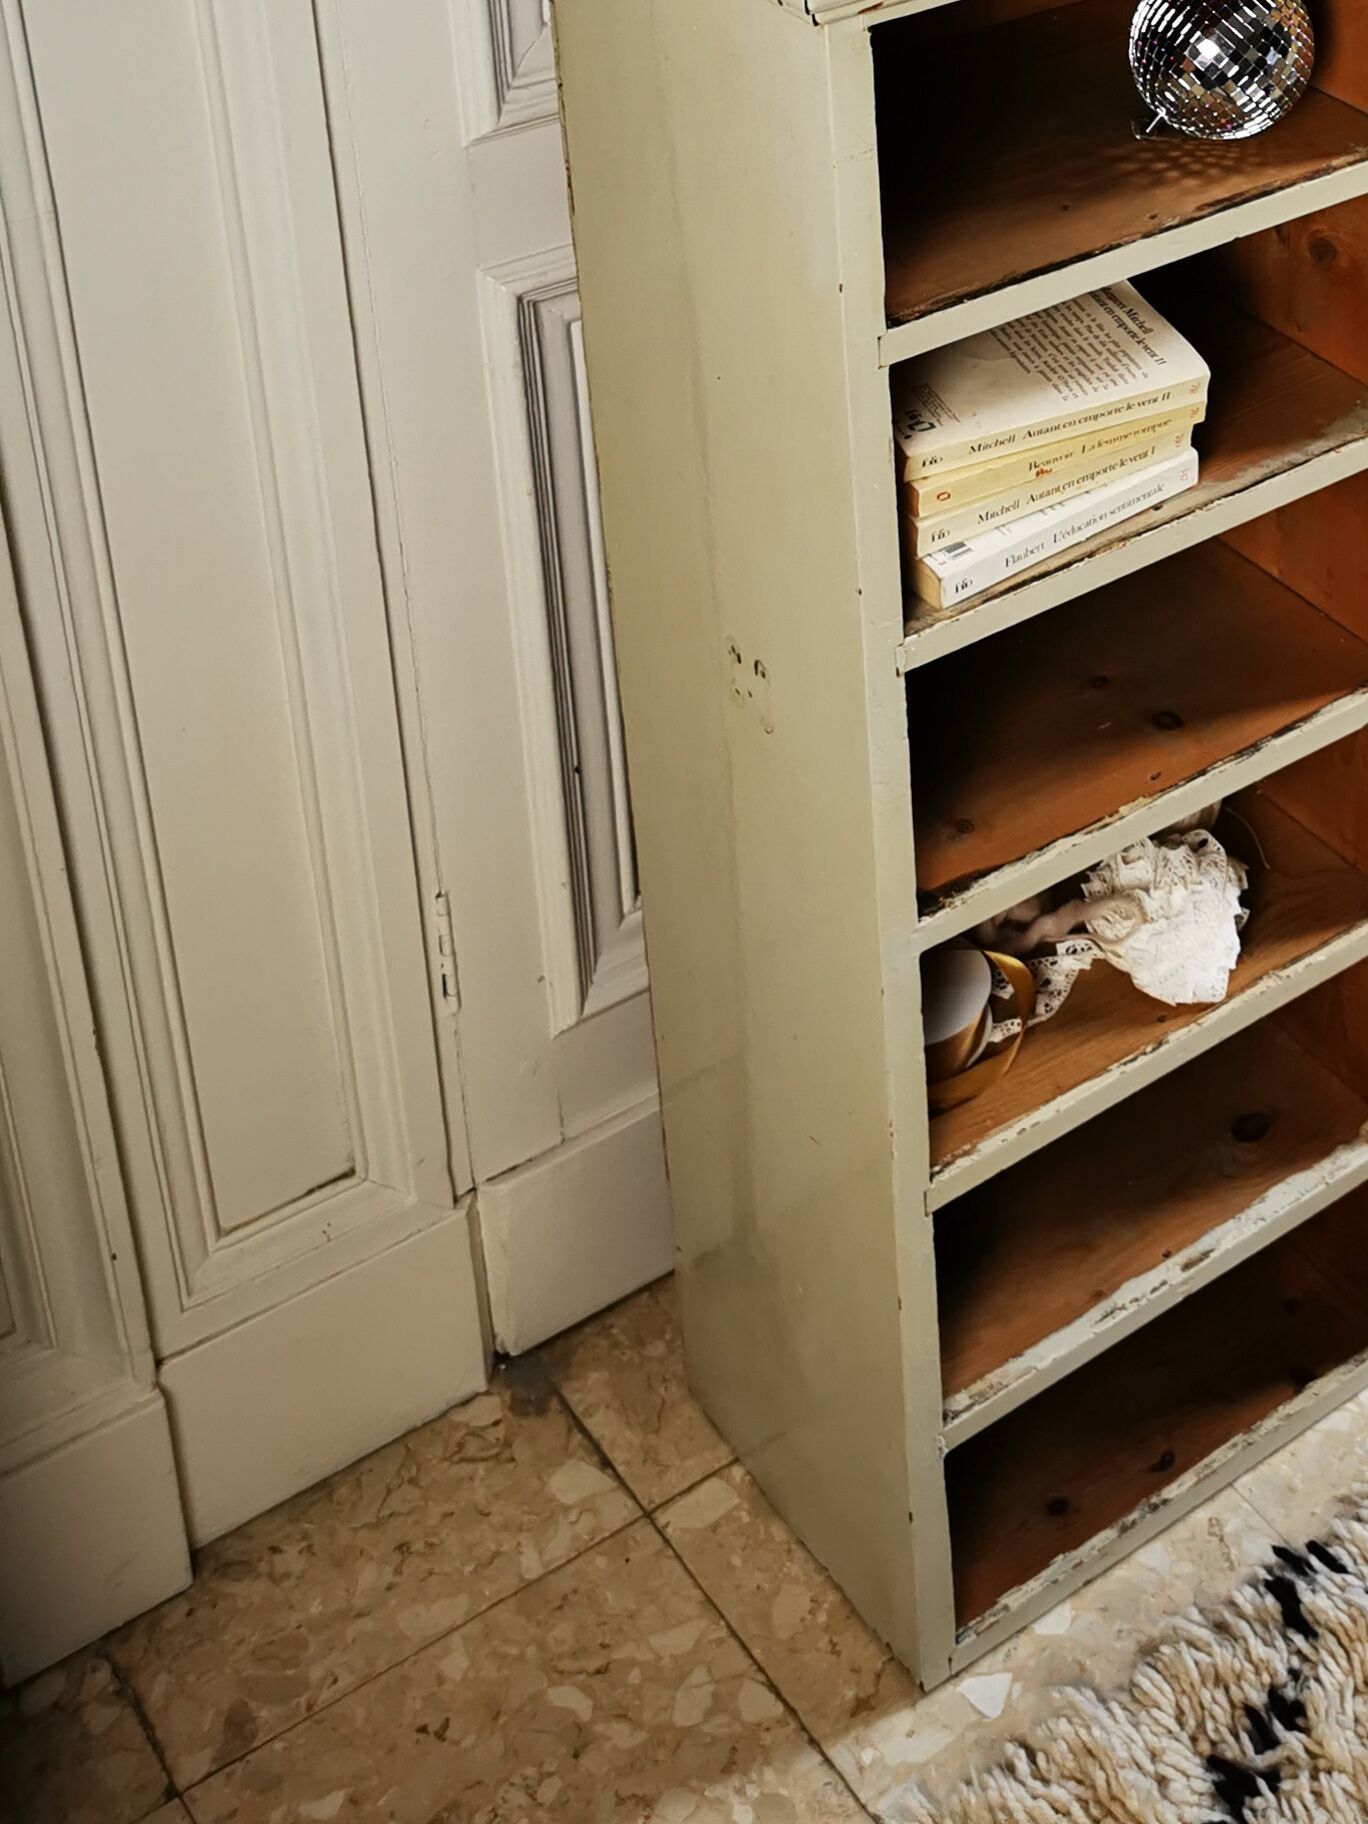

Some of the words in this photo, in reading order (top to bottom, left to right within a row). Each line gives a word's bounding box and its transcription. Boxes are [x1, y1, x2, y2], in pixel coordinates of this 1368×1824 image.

[968, 434, 1016, 455] Mitchell
[1022, 422, 1061, 440] Autant
[1063, 419, 1077, 429] en
[1078, 406, 1125, 426] emporte
[977, 499, 1020, 524] Mitchell
[1026, 486, 1062, 505] Autant
[1062, 480, 1075, 490] en
[1076, 465, 1118, 485] emporte
[1005, 542, 1045, 568] Flaubert
